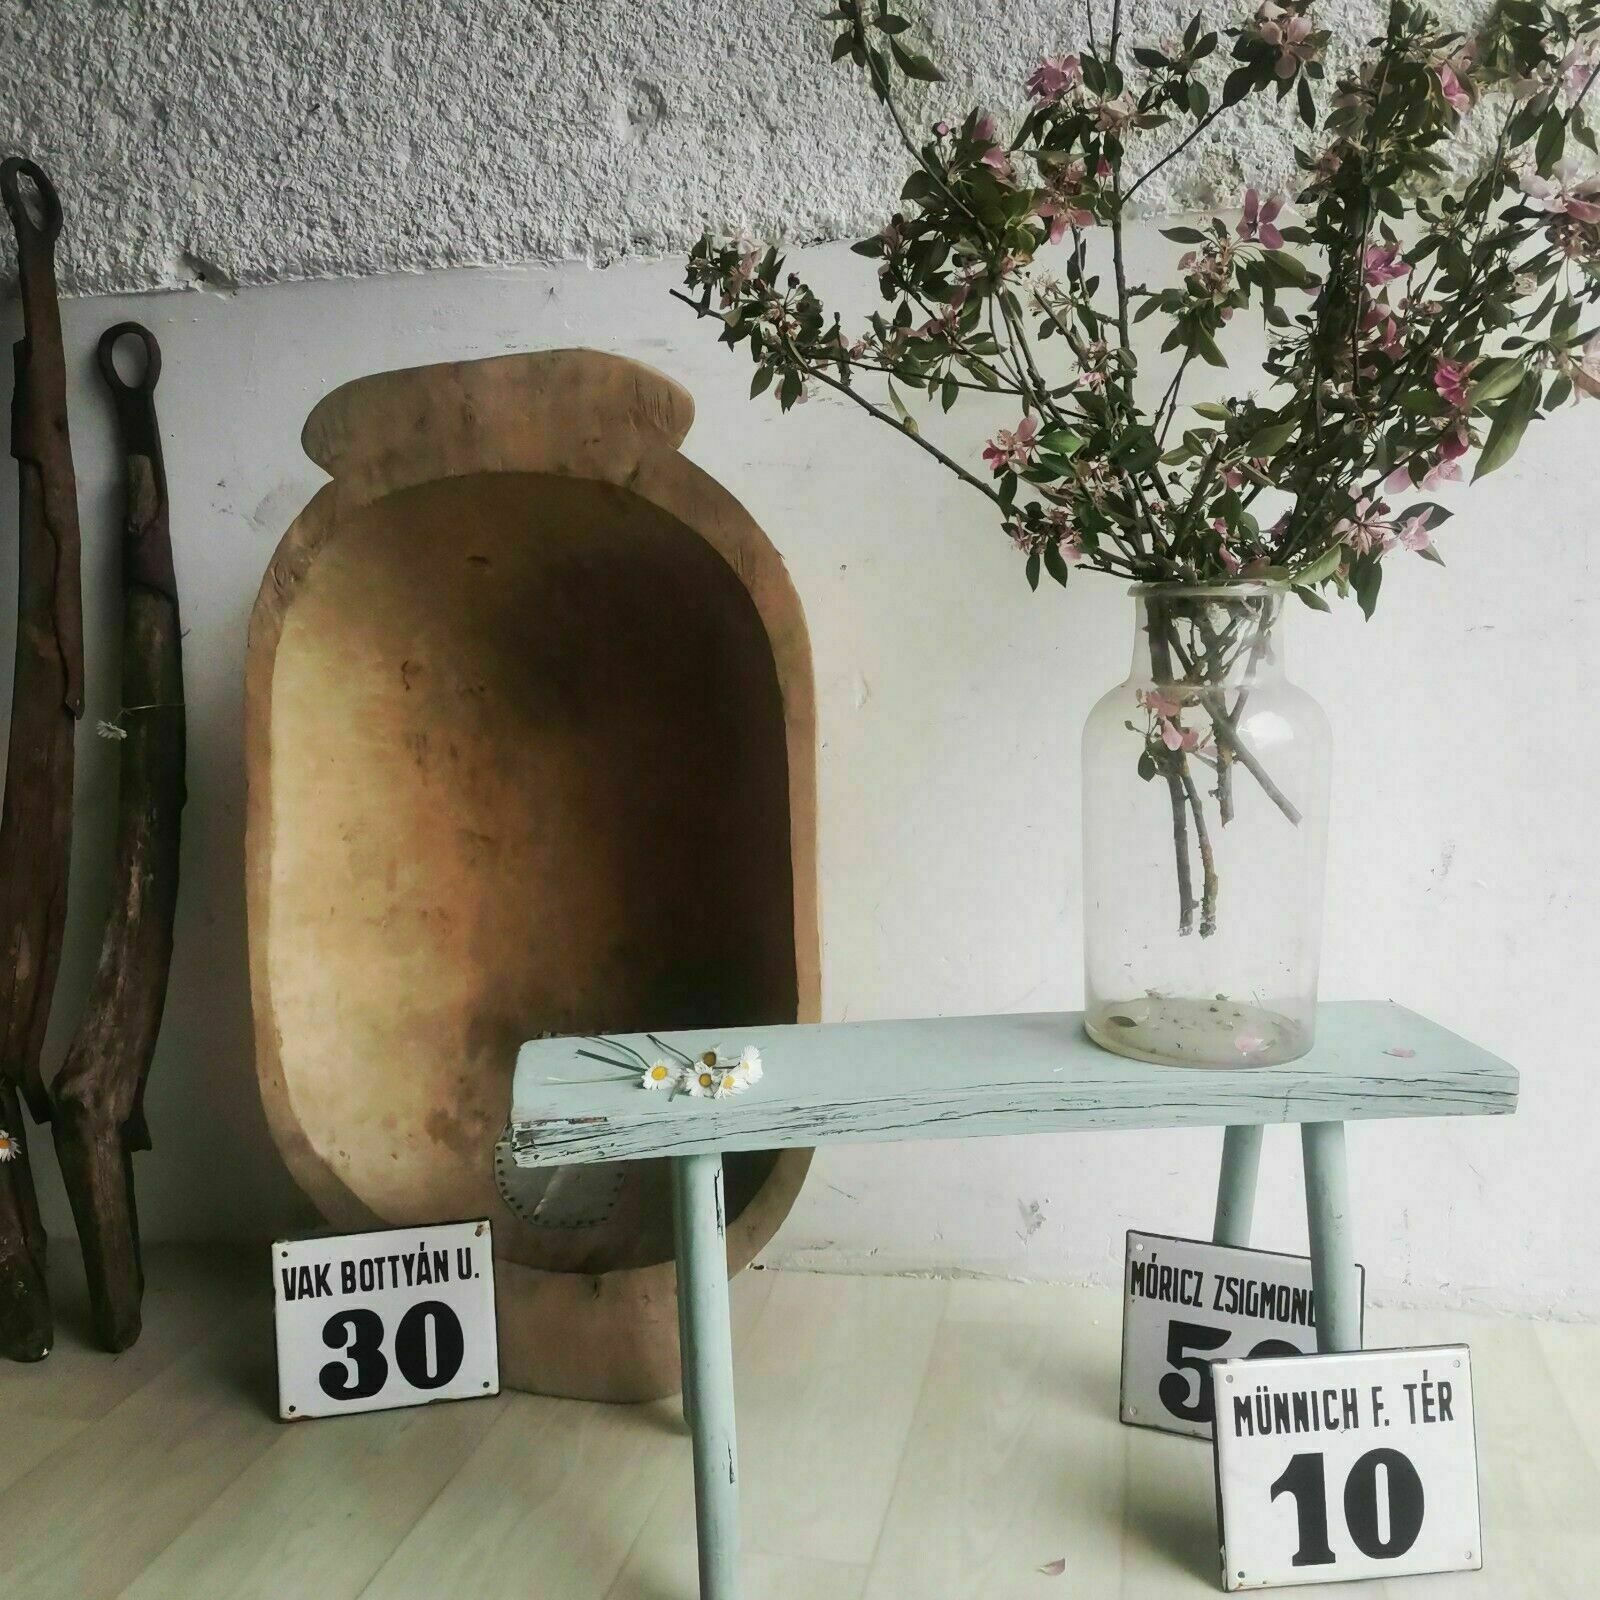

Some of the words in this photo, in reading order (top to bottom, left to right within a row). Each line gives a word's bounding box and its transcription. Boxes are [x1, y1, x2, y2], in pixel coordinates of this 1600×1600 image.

[281, 1262, 333, 1301] VAK
[341, 1241, 449, 1295] BOTTYÁN
[456, 1247, 480, 1280] U.
[1130, 1252, 1204, 1308] MÓRICZ
[318, 1300, 465, 1401] 30
[1158, 1319, 1304, 1423] 5
[1233, 1385, 1360, 1437] MÜNNICH
[1371, 1385, 1390, 1428] F.
[1402, 1369, 1454, 1425] TÉR
[1270, 1447, 1425, 1567] 10
